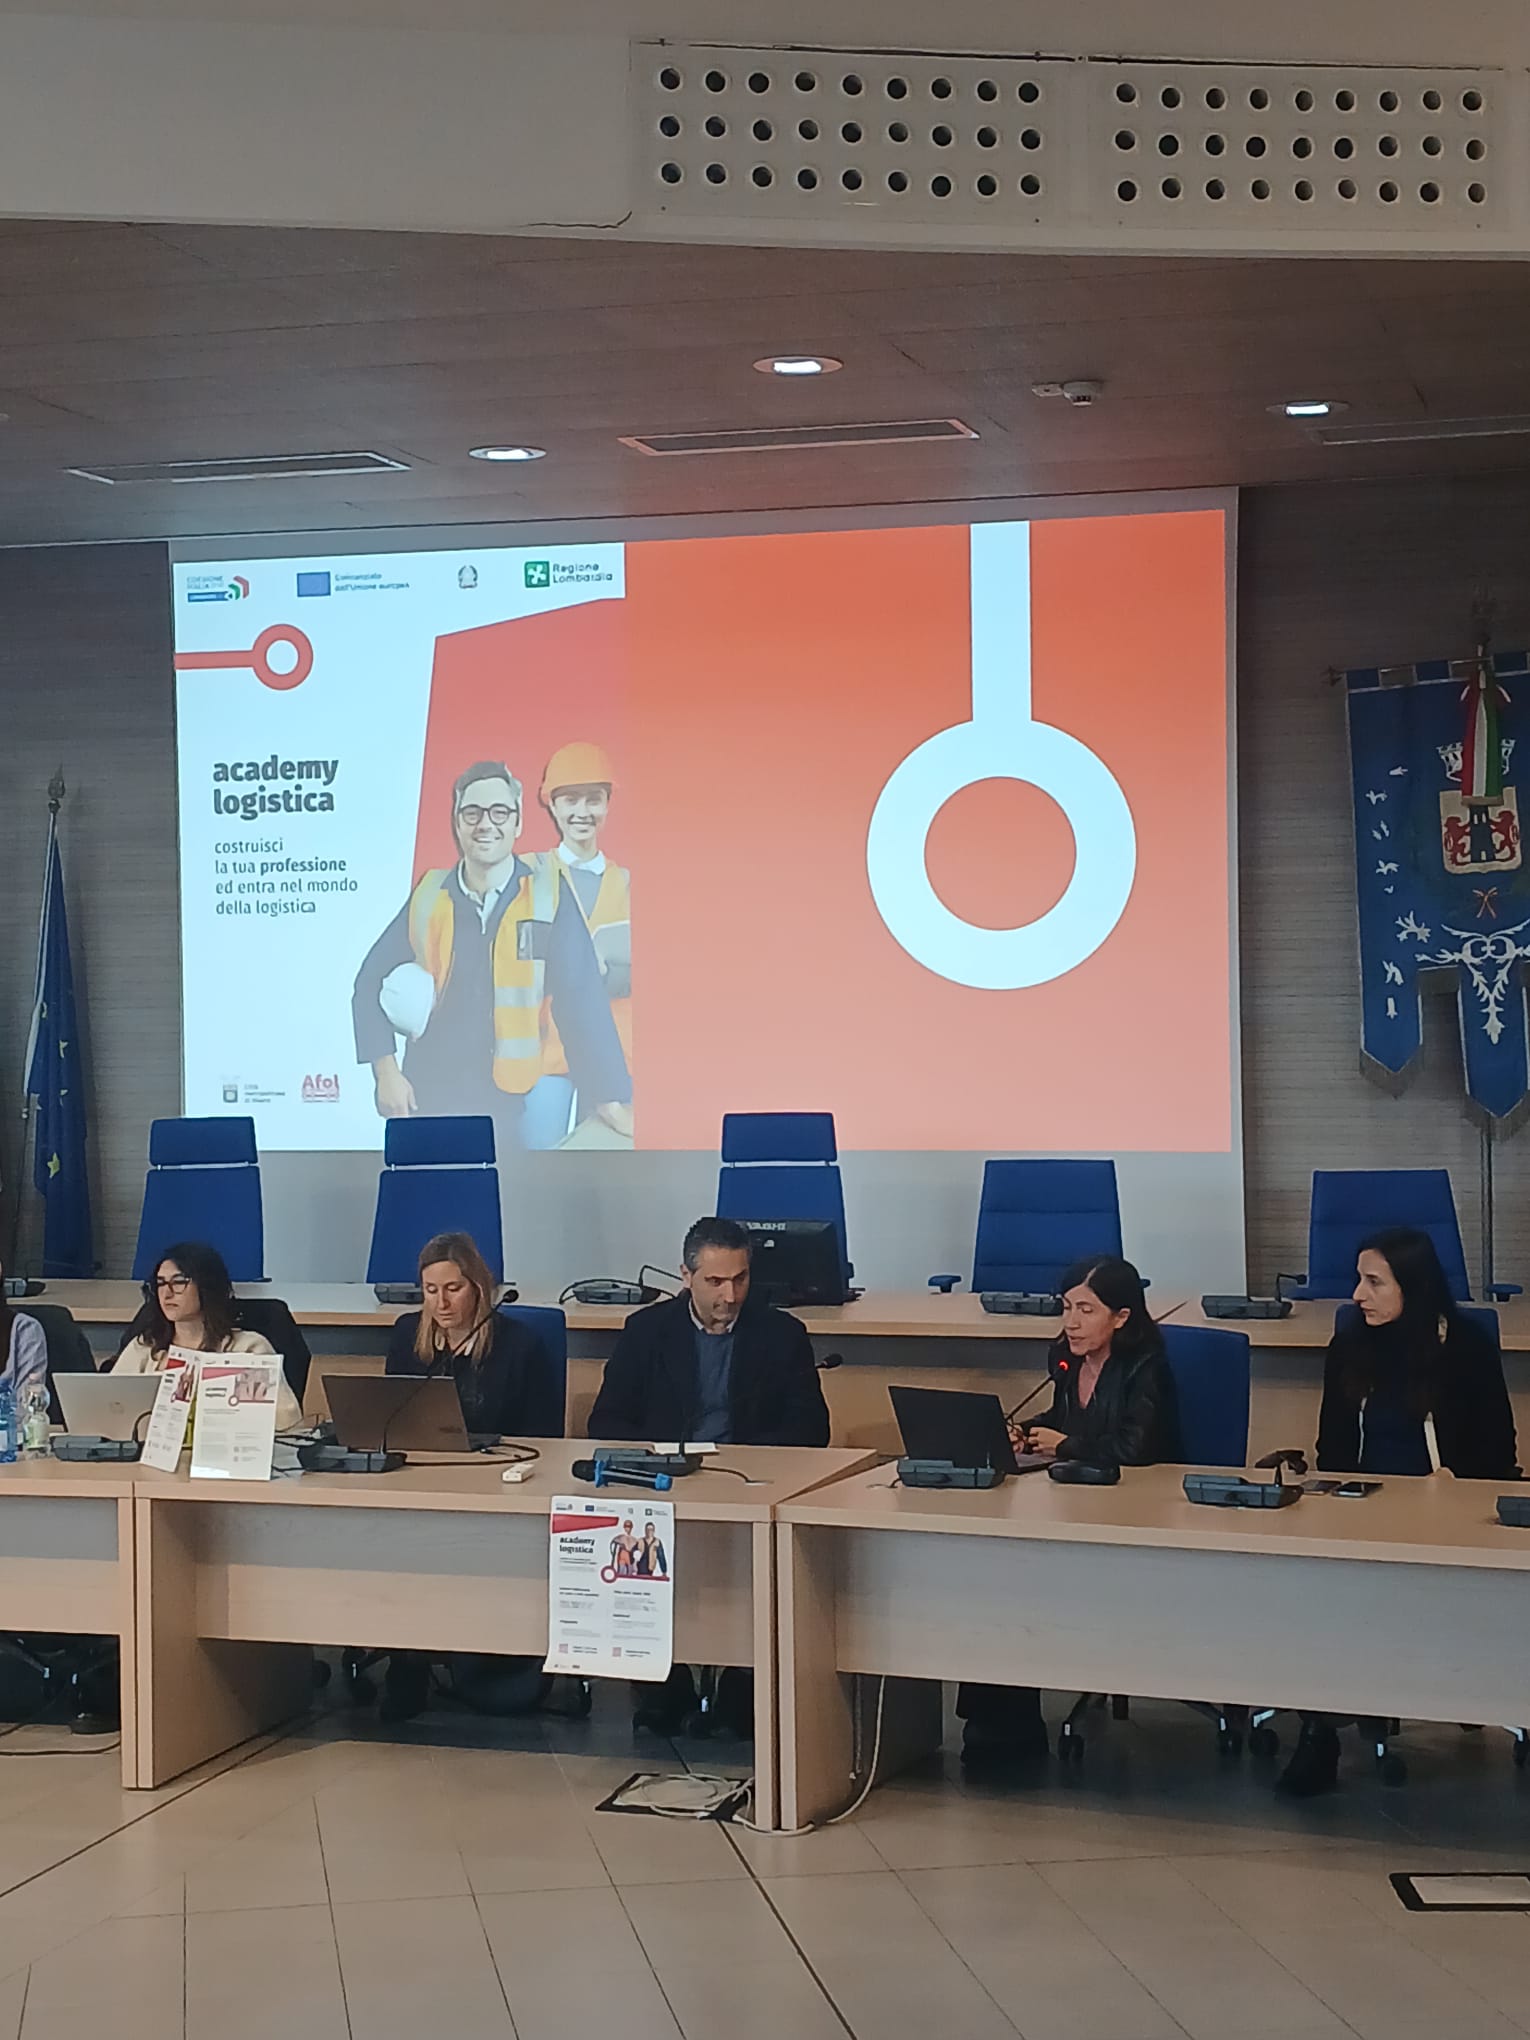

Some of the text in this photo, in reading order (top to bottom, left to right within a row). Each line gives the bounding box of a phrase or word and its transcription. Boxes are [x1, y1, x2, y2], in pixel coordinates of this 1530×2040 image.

[552, 563, 599, 574] Regione
[552, 573, 613, 583] Lombardia
[213, 754, 339, 786] academy
[213, 784, 335, 821] logistica
[215, 837, 284, 854] costruisci
[215, 857, 347, 876] la tua professione
[216, 877, 358, 894] ed entra nel mondo
[216, 898, 316, 917] della logistica
[302, 1073, 340, 1089] Afol
